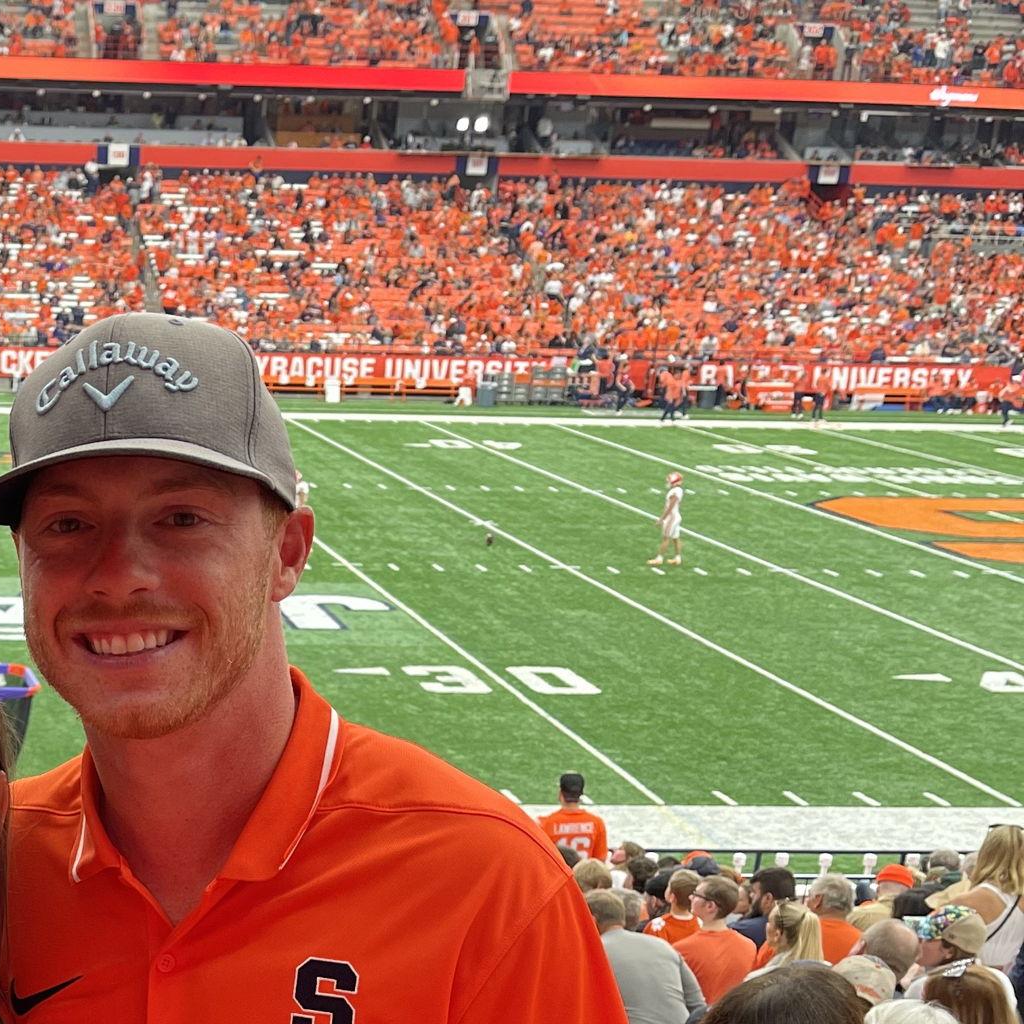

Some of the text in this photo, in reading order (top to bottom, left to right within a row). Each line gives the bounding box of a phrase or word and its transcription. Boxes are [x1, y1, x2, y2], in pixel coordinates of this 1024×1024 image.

[36, 340, 199, 415] Callaway
[255, 356, 376, 379] YRACUSE
[812, 365, 974, 390] UNIVERSTY
